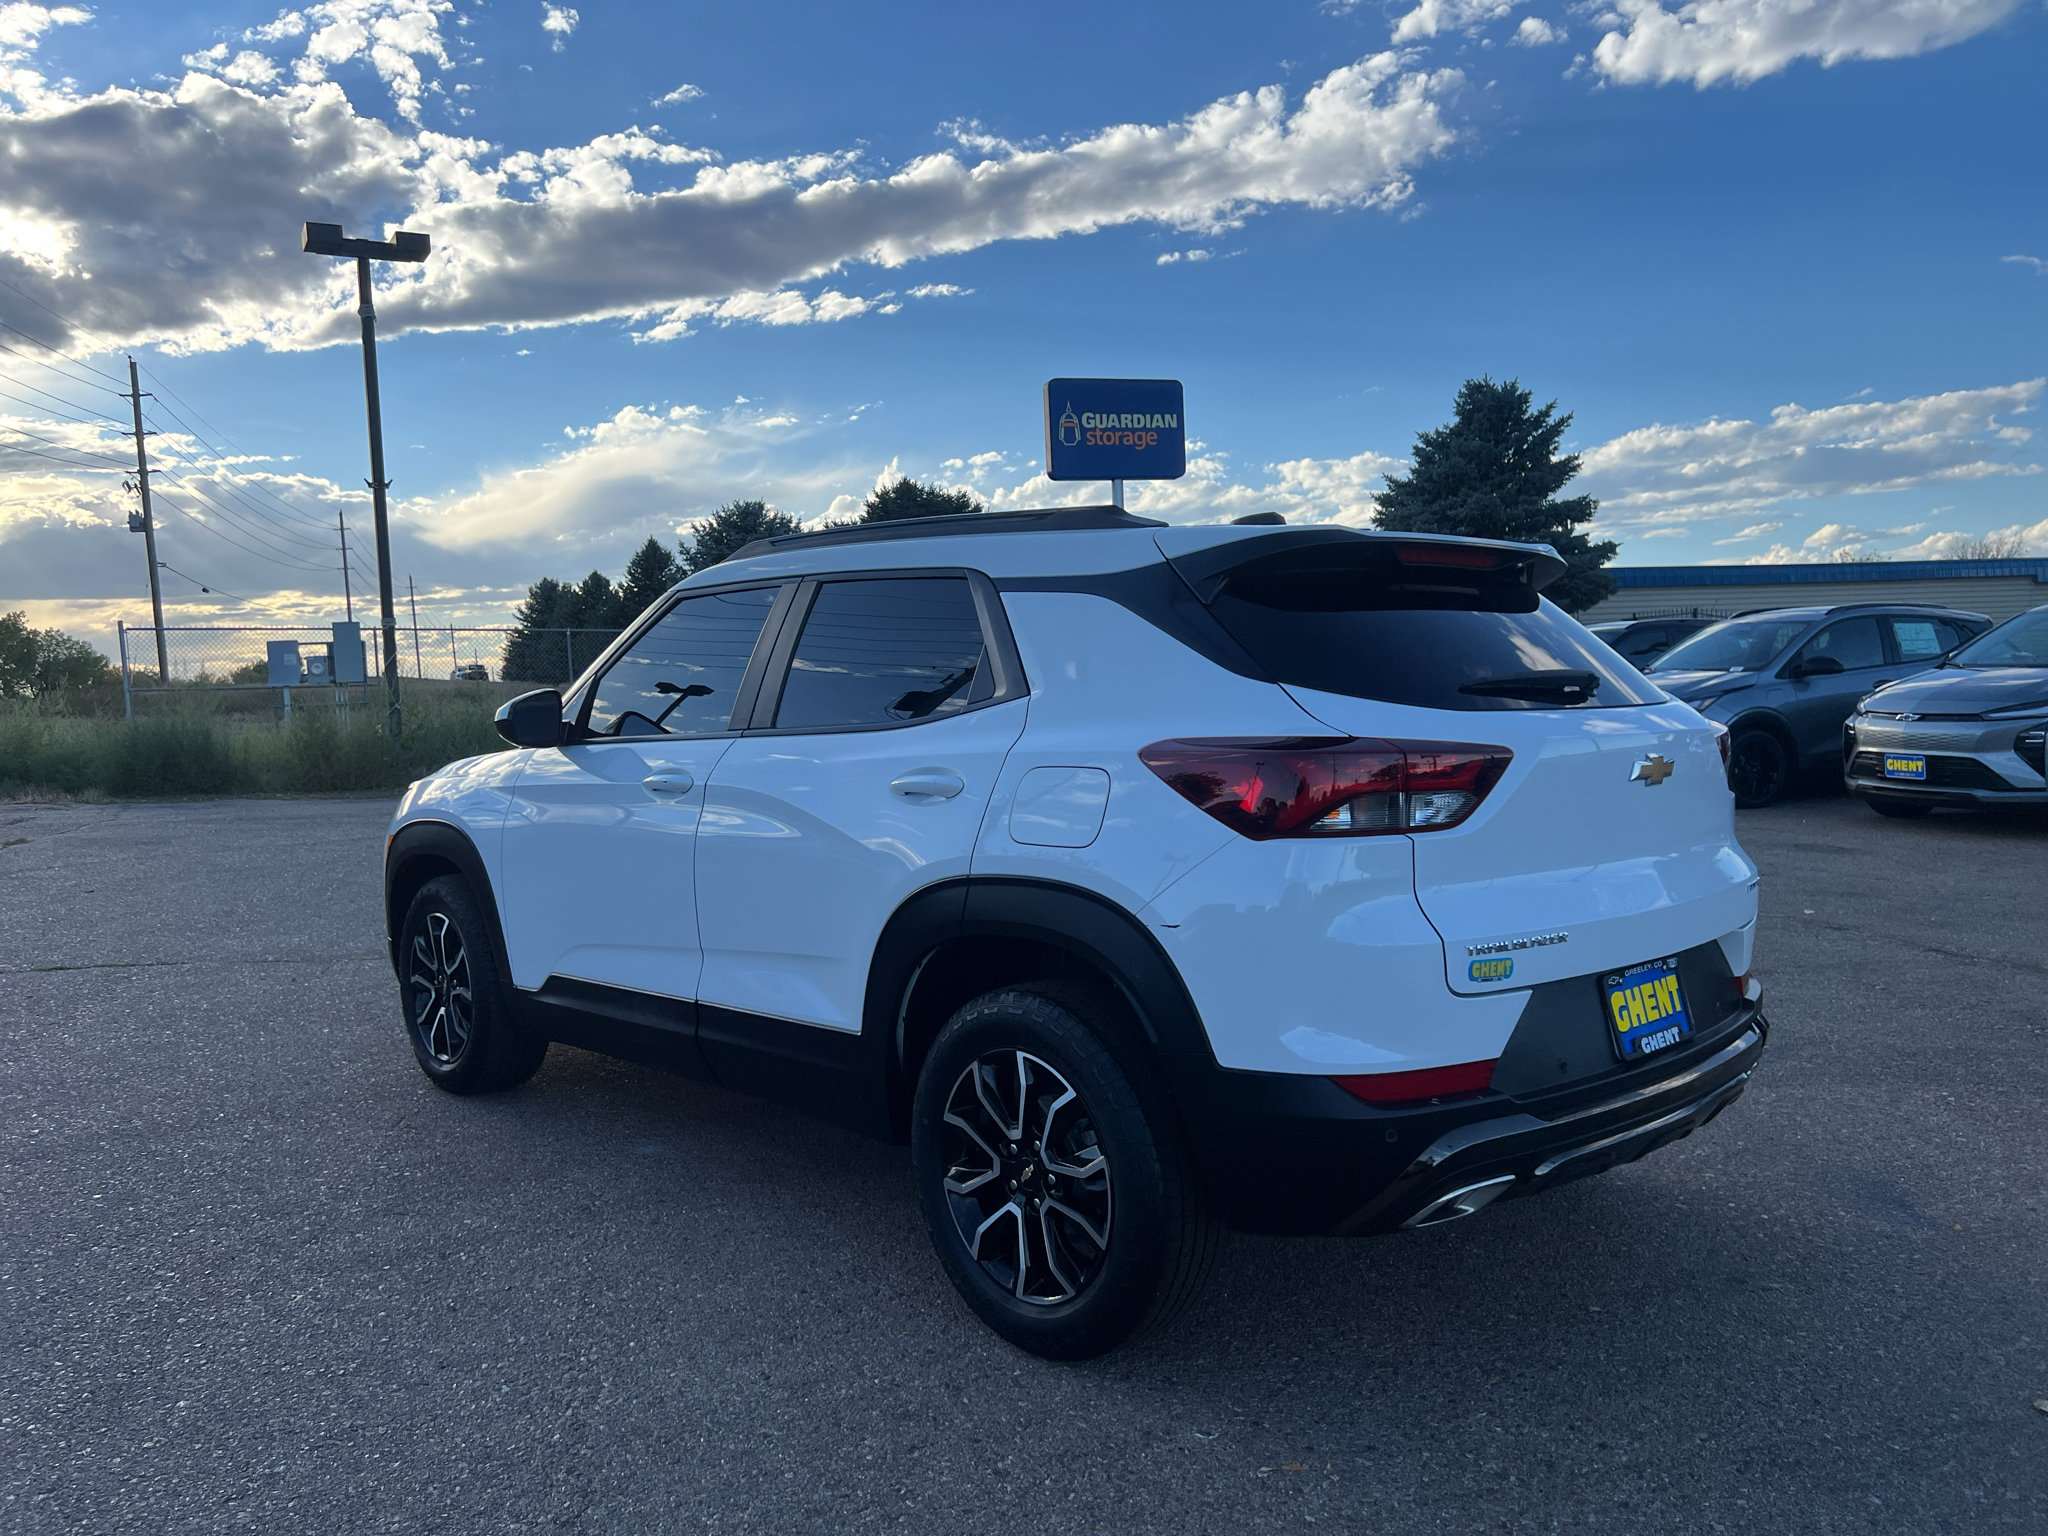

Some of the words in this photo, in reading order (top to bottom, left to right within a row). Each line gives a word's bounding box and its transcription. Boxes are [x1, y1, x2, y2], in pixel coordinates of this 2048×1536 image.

[1081, 412, 1178, 428] GUARDIAN
[1086, 427, 1158, 450] storage
[1886, 758, 1923, 772] GHENT
[1465, 931, 1569, 956] TRAILBLAZER
[1471, 960, 1512, 978] GHENT
[1653, 960, 1663, 969] CO
[1610, 974, 1681, 1032] GHENT
[1641, 1026, 1680, 1054] GHENT
